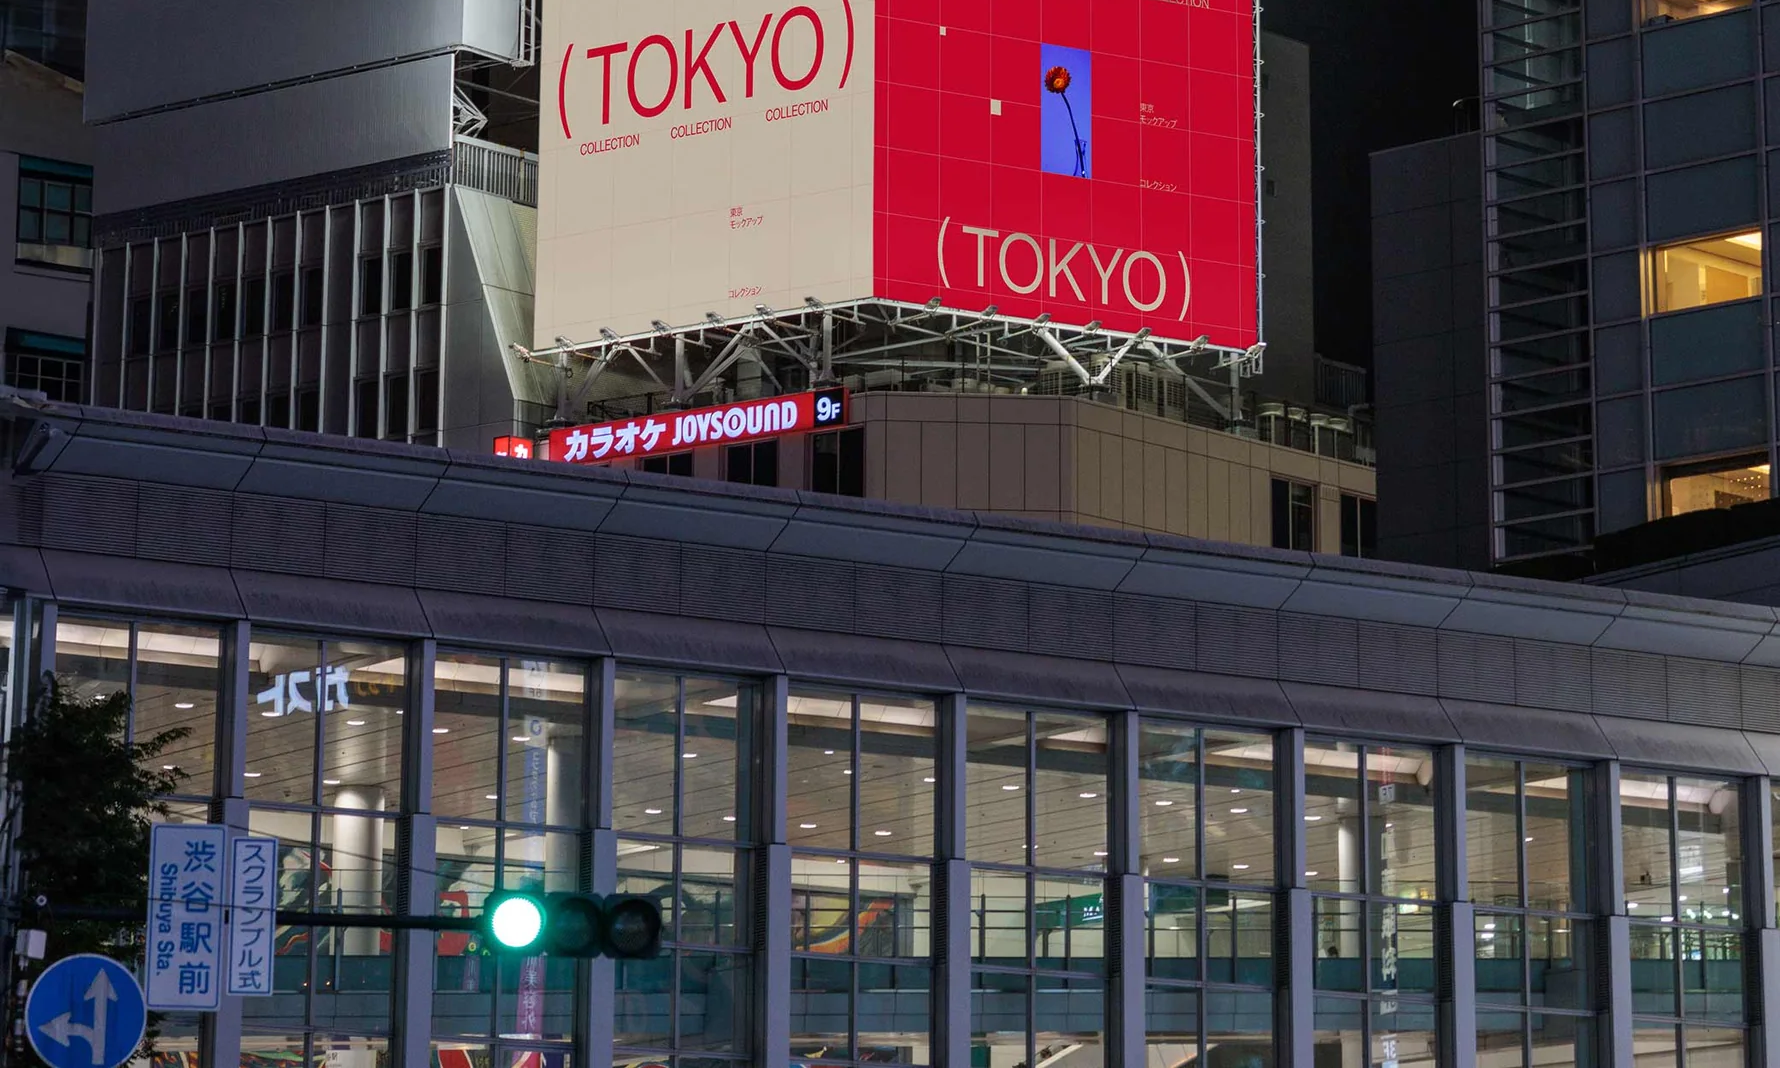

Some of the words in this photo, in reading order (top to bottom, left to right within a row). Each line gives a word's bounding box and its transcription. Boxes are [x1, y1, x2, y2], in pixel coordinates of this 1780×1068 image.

[1140, 103, 1154, 113] 東京
[1140, 115, 1177, 128] モックアップ
[580, 134, 640, 156] COLLECTION
[670, 117, 732, 139] COLLECTION
[765, 99, 829, 122] COLLECTION
[1140, 179, 1177, 192] コレクション
[730, 206, 743, 217] 東京
[730, 216, 763, 229] モックアップ
[937, 216, 1190, 322] (TOKYO)
[728, 286, 762, 298] コレクション
[564, 422, 666, 462] カラオケ
[672, 399, 798, 446] JOYSOUND
[816, 396, 841, 421] 9F
[156, 863, 178, 934] Shibuya
[239, 844, 266, 990] スクランブル式
[178, 840, 216, 995] 渋谷駅前
[156, 940, 175, 977] Sta.
